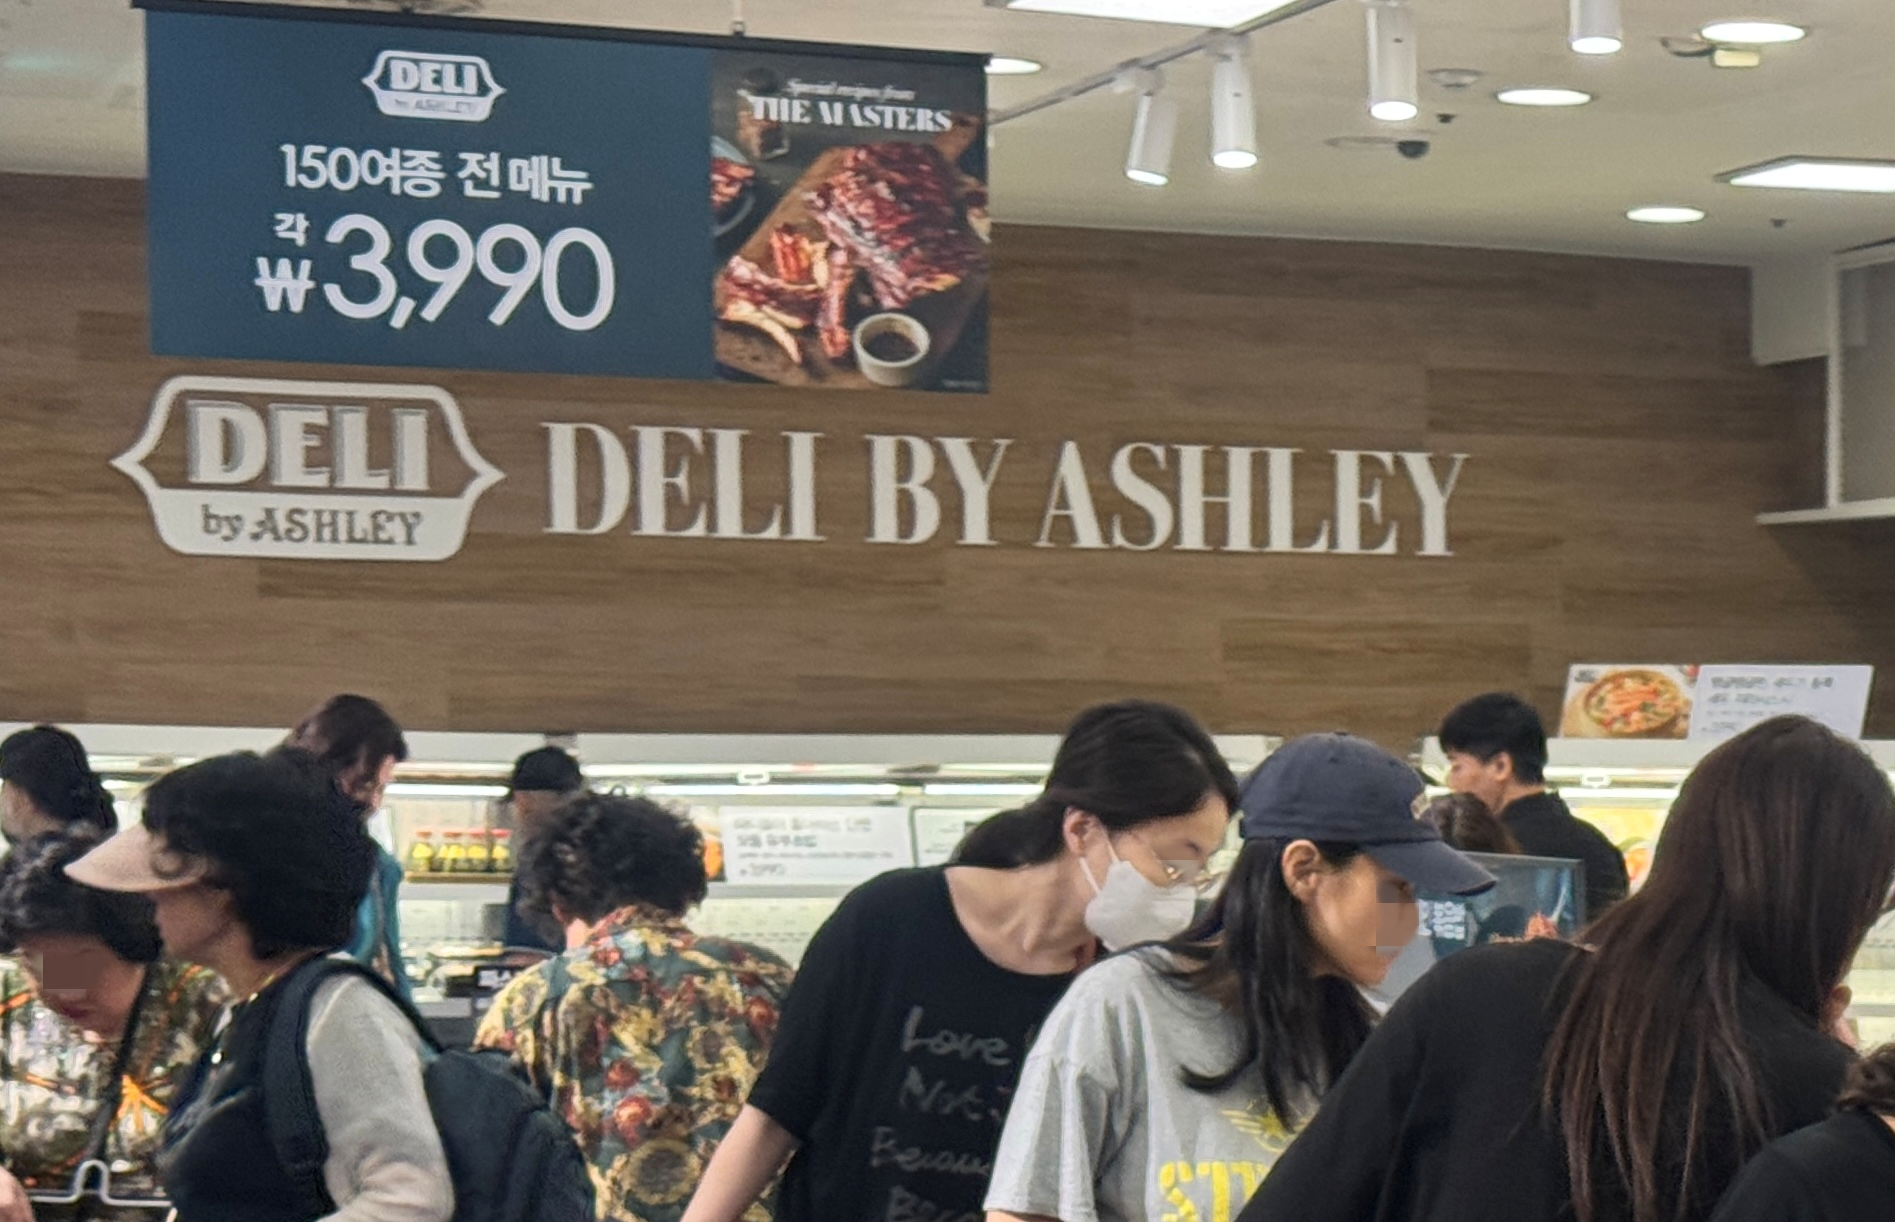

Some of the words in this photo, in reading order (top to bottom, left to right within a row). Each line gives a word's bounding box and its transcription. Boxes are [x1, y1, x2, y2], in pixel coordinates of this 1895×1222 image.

[389, 59, 478, 95] DELI
[750, 95, 811, 124] THE
[818, 101, 953, 133] MASTERS
[281, 144, 446, 198] 150여종
[457, 152, 501, 198] 전
[508, 155, 594, 204] 메뉴
[274, 212, 309, 247] 각
[187, 402, 430, 492] DELI
[541, 421, 826, 543] DELI
[863, 433, 1016, 547] BY
[1031, 439, 1472, 559] ASHLEY
[201, 503, 244, 540] by
[250, 504, 425, 548] ASHLEY
[902, 1005, 1011, 1067] Love
